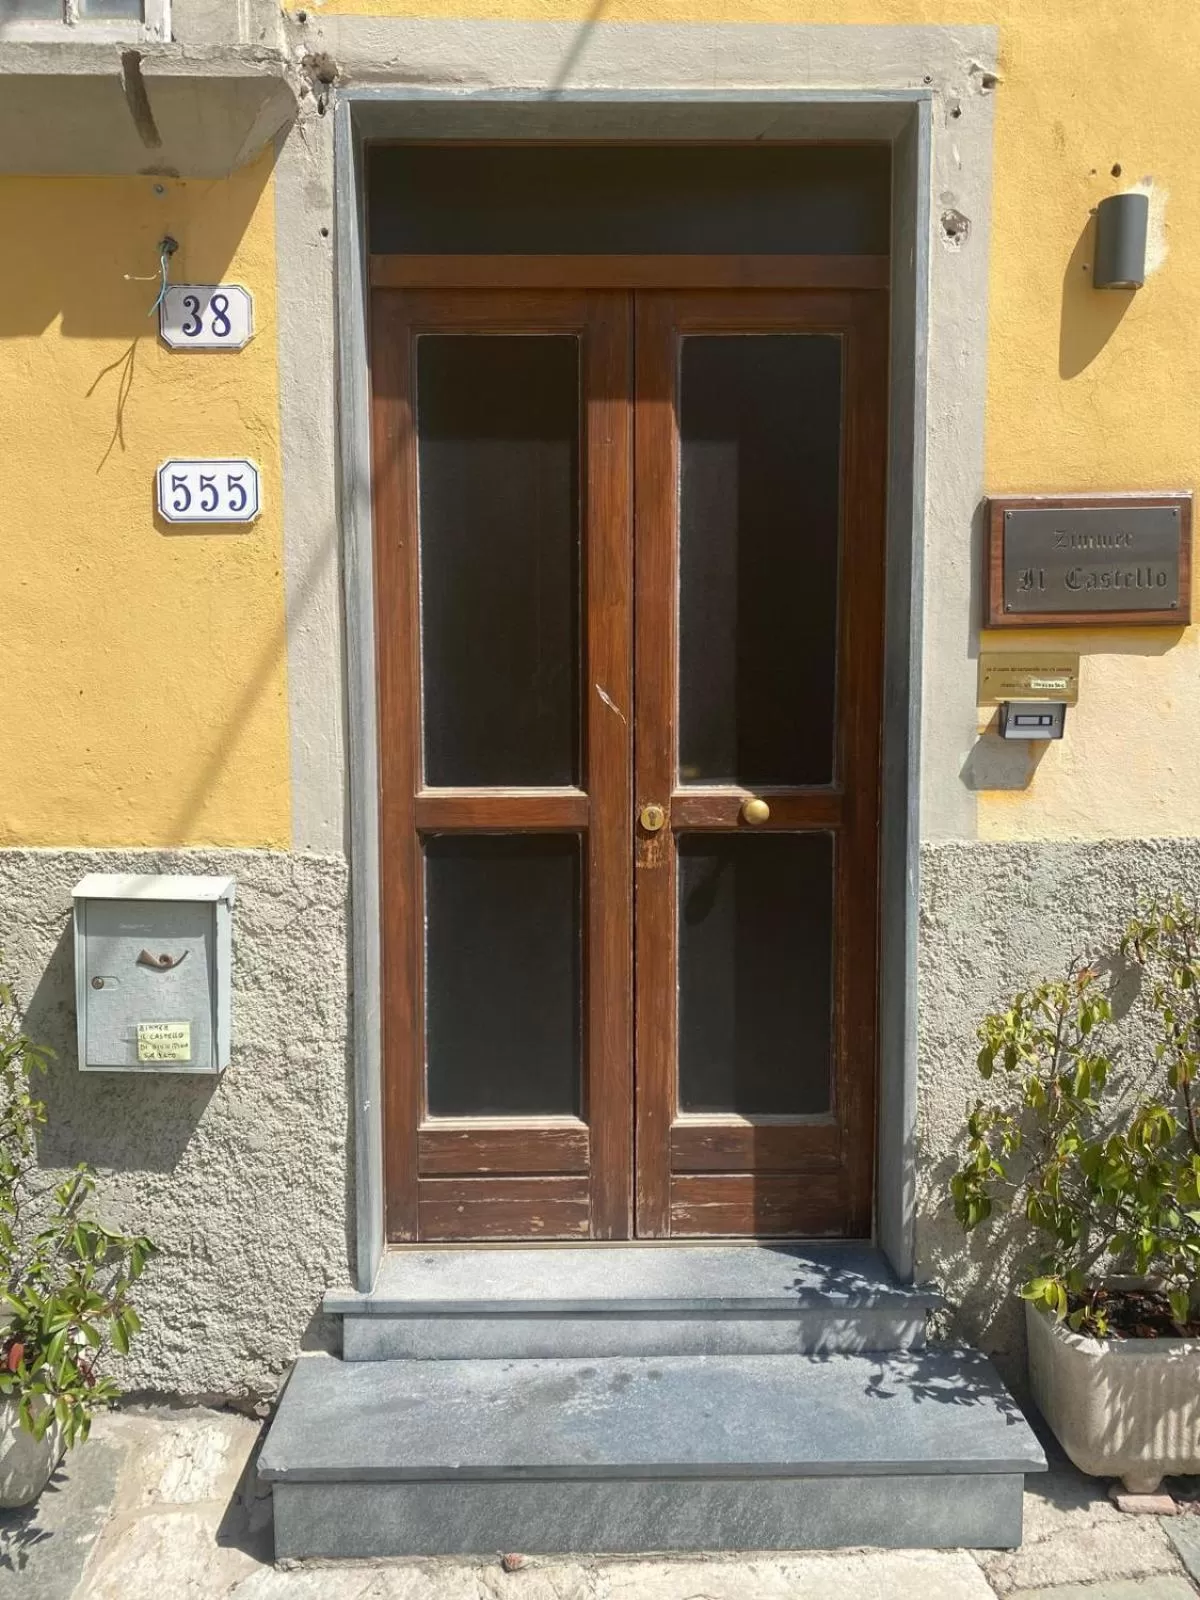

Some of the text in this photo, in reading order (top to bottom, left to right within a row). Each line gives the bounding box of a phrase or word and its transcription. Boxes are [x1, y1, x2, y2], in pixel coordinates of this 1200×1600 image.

[182, 293, 232, 338] 38
[171, 474, 248, 512] 555
[1053, 529, 1134, 550] Zimmer
[1016, 567, 1168, 592] Il Castello
